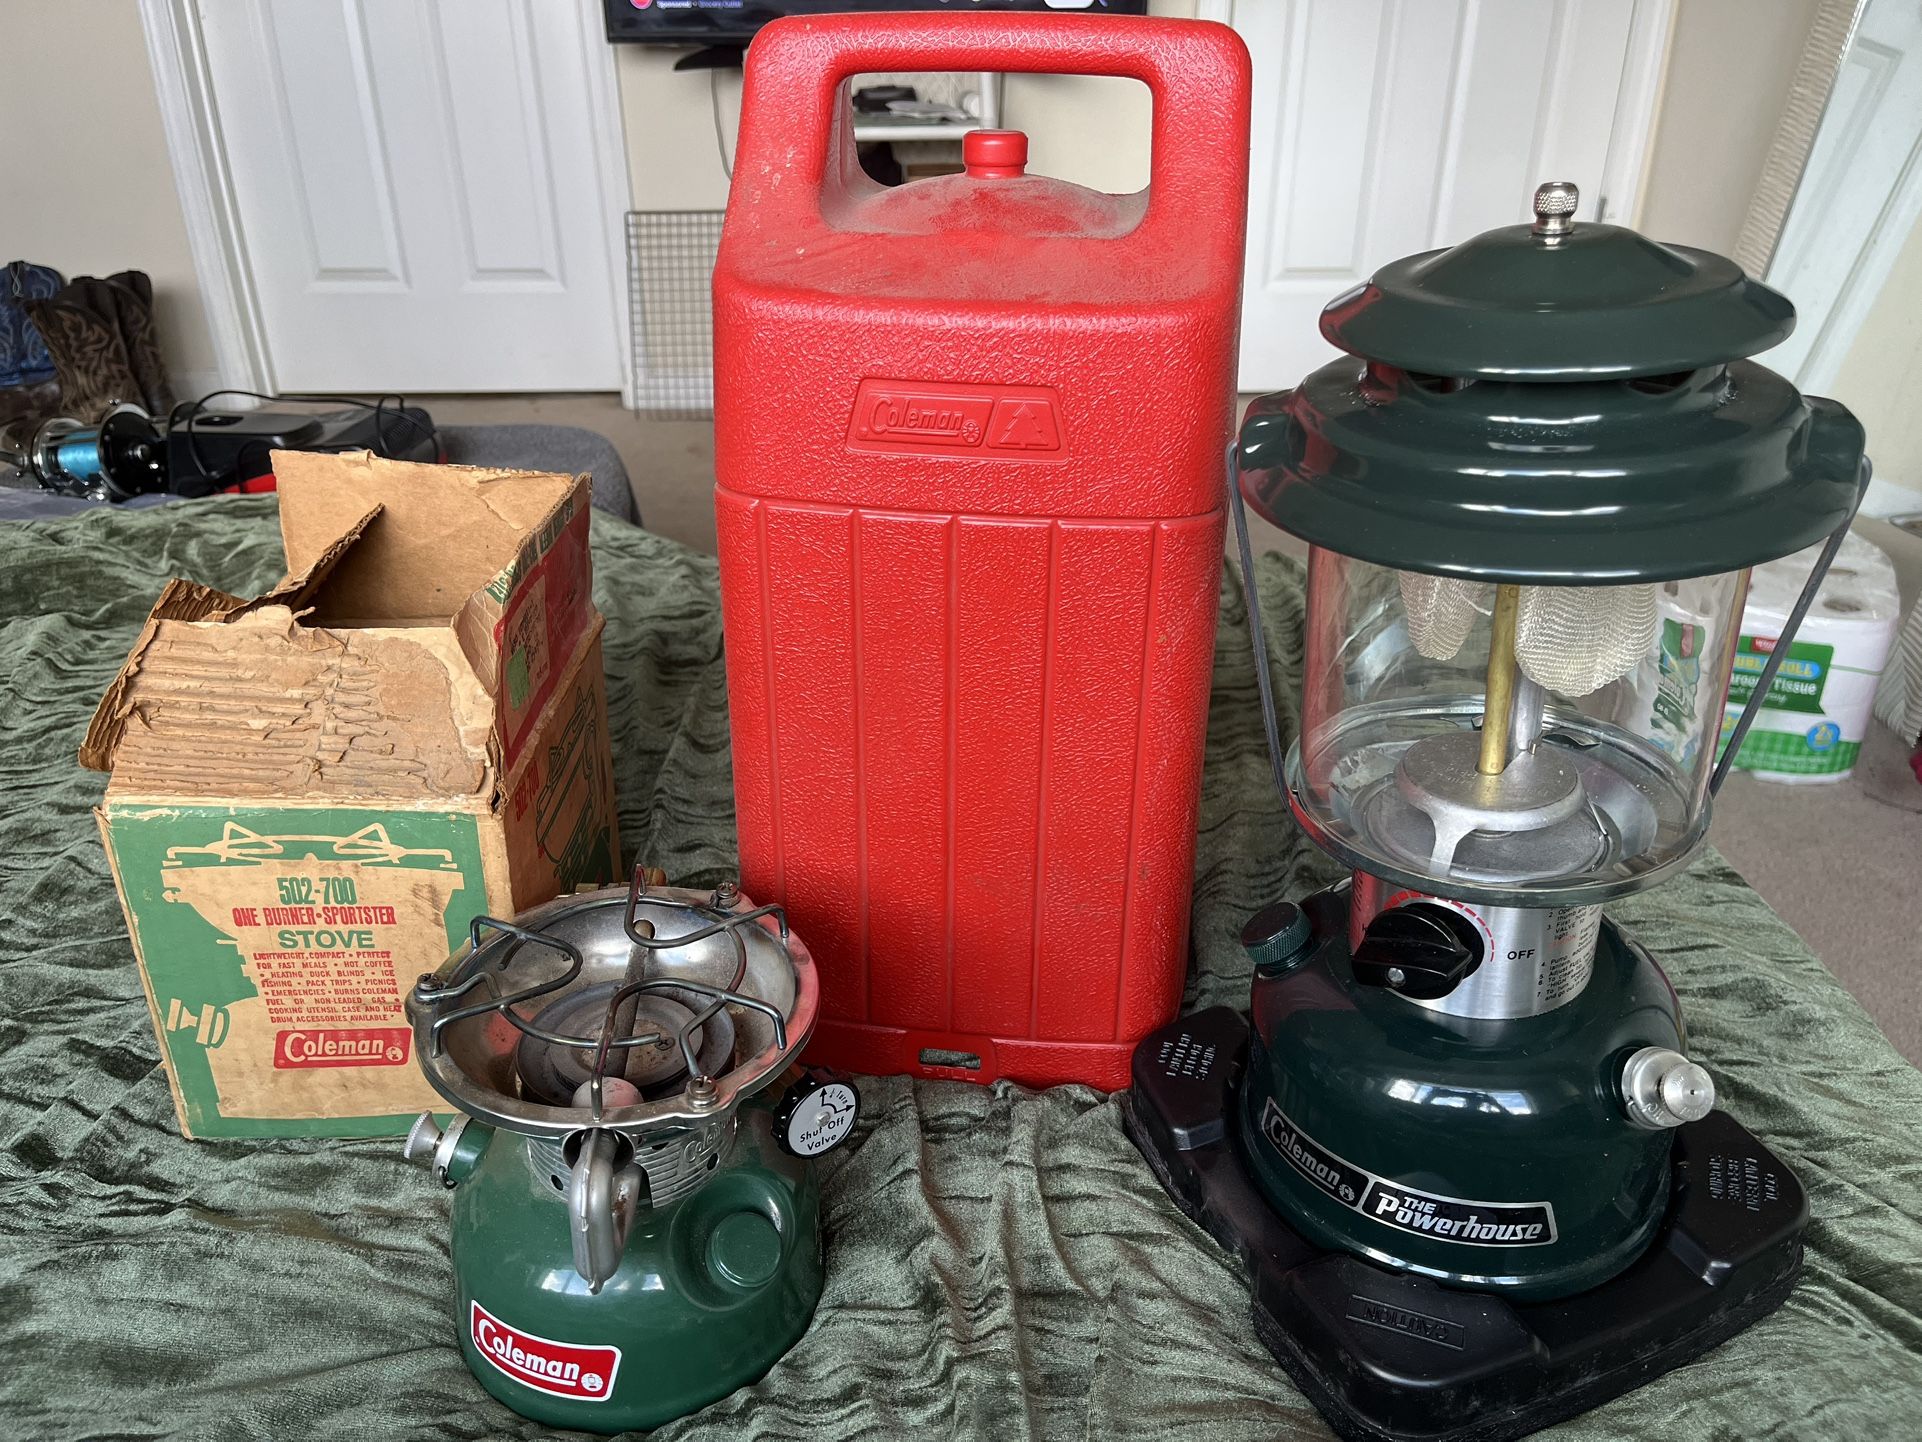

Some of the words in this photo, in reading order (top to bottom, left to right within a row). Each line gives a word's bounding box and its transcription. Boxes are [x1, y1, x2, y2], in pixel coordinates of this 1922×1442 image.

[868, 394, 965, 435] Coleman
[277, 877, 358, 905] 502-700
[232, 907, 261, 927] ONE
[263, 907, 317, 926] BURNER
[322, 905, 397, 925] SPORTSTER
[277, 929, 375, 949] STOVE
[309, 951, 346, 960] COMPACT
[356, 951, 392, 959] PERFECT
[1507, 948, 1535, 960] OFF
[256, 962, 272, 970] FOR
[301, 961, 328, 969] MEALS
[364, 960, 394, 968] COFFEE
[270, 971, 303, 979] HEATING
[309, 970, 331, 978] DUCK
[381, 969, 396, 977] ICE
[261, 979, 293, 988] FISHING
[306, 979, 326, 987] PACK
[330, 979, 353, 987] TRIPS
[364, 978, 397, 986] PICNICS
[271, 988, 326, 997] EMERGENCIES
[362, 987, 399, 995] COLEMAN
[266, 998, 286, 1006] FUEL
[268, 1007, 303, 1015] COOKING
[306, 1006, 338, 1014] UTENSIL
[341, 1005, 361, 1013] CASE
[383, 1004, 402, 1013] HEAT
[270, 1016, 293, 1024] DRUM
[296, 1015, 348, 1023] ACCESSORIES
[284, 1031, 384, 1063] Coleman
[800, 1127, 823, 1143] Shut
[827, 1115, 845, 1130] Off
[807, 1134, 837, 1151] Valve
[1268, 1114, 1342, 1188] Coleman
[1403, 1195, 1437, 1215] THE
[1375, 1192, 1543, 1241] Powerhouse
[1363, 1304, 1449, 1341] CAUTION
[478, 1318, 580, 1381] Coleman
